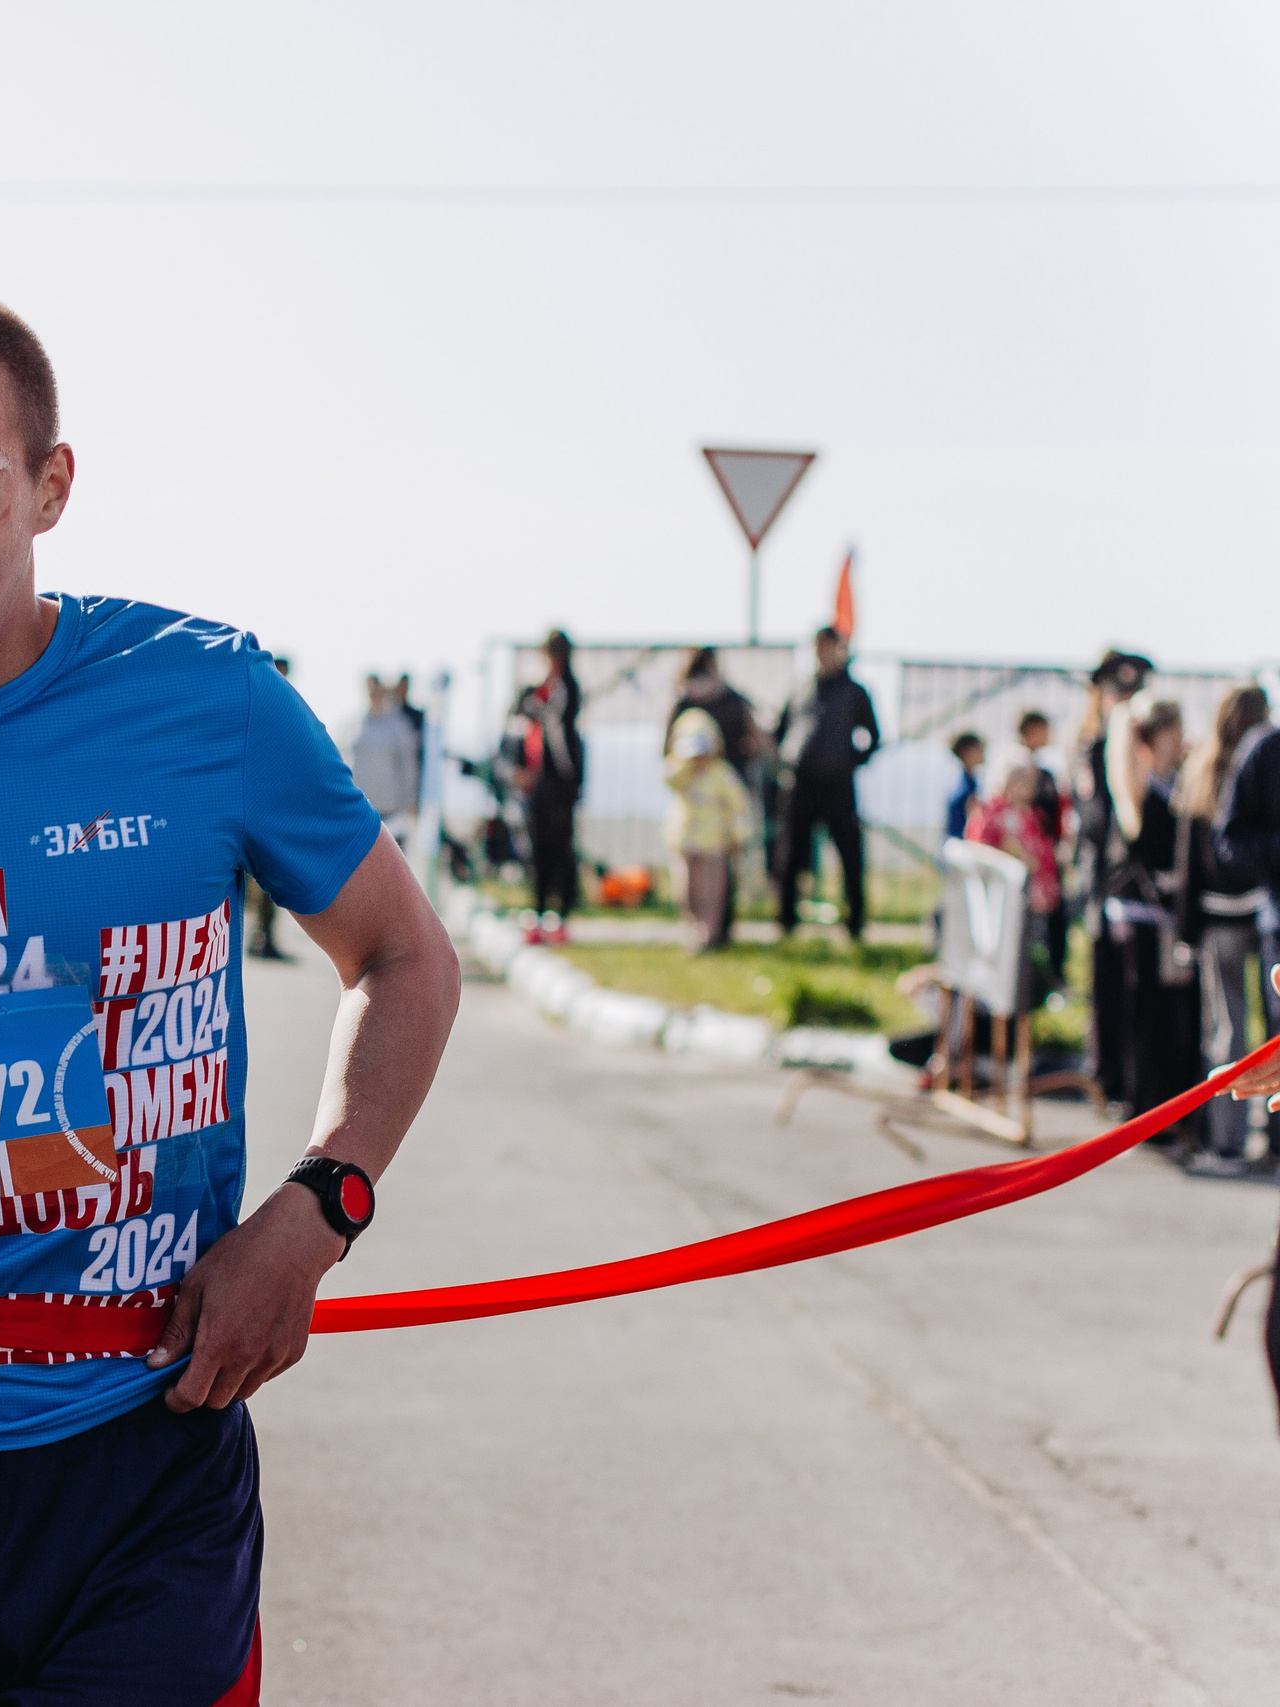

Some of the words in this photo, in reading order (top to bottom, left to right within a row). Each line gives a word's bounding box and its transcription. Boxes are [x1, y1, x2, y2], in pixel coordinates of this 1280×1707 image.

[100, 896, 230, 998] #ЦЕЛЬ
[104, 1047, 230, 1149] ОМЕНТ
[91, 1159, 118, 1182] #МЕЧТА
[80, 1209, 198, 1292] 2024
